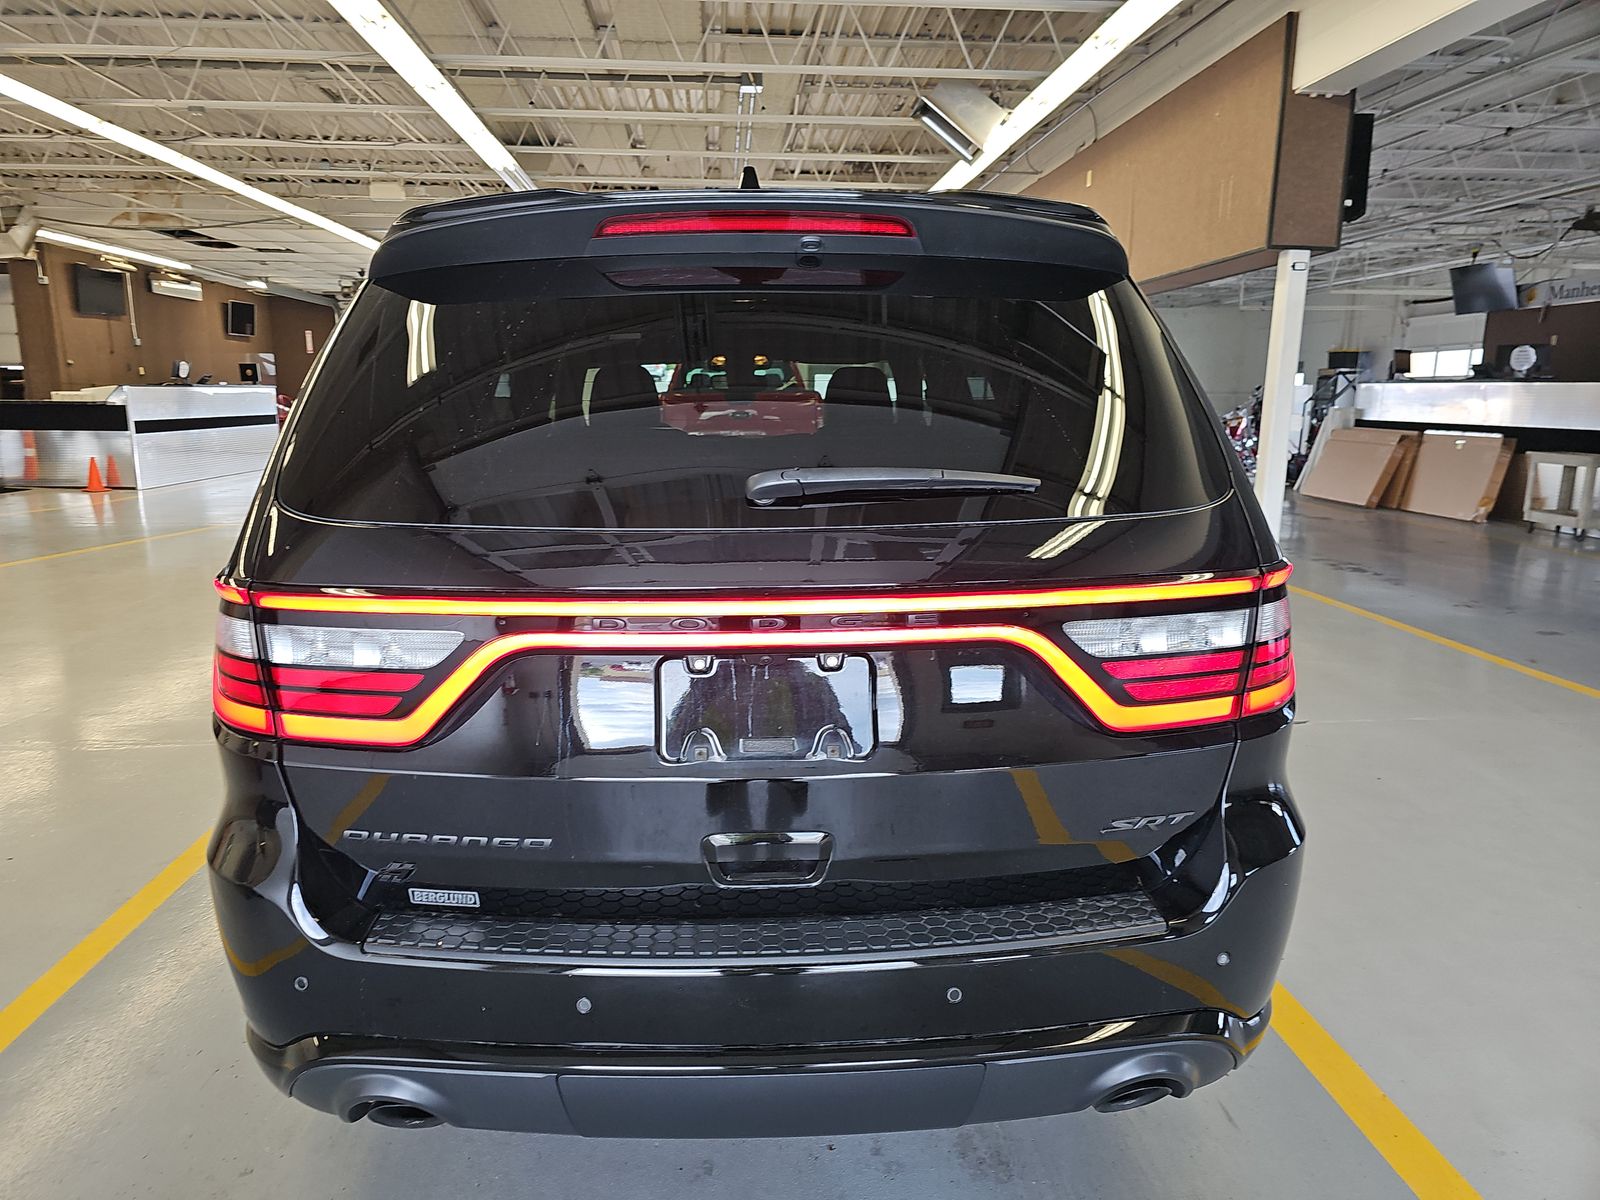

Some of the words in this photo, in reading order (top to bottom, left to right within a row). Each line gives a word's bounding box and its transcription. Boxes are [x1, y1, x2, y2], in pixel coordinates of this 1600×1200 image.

[592, 613, 939, 631] DODGE
[1100, 811, 1195, 833] SRT
[342, 829, 553, 849] DURANGO
[412, 890, 477, 905] BERGLUND
